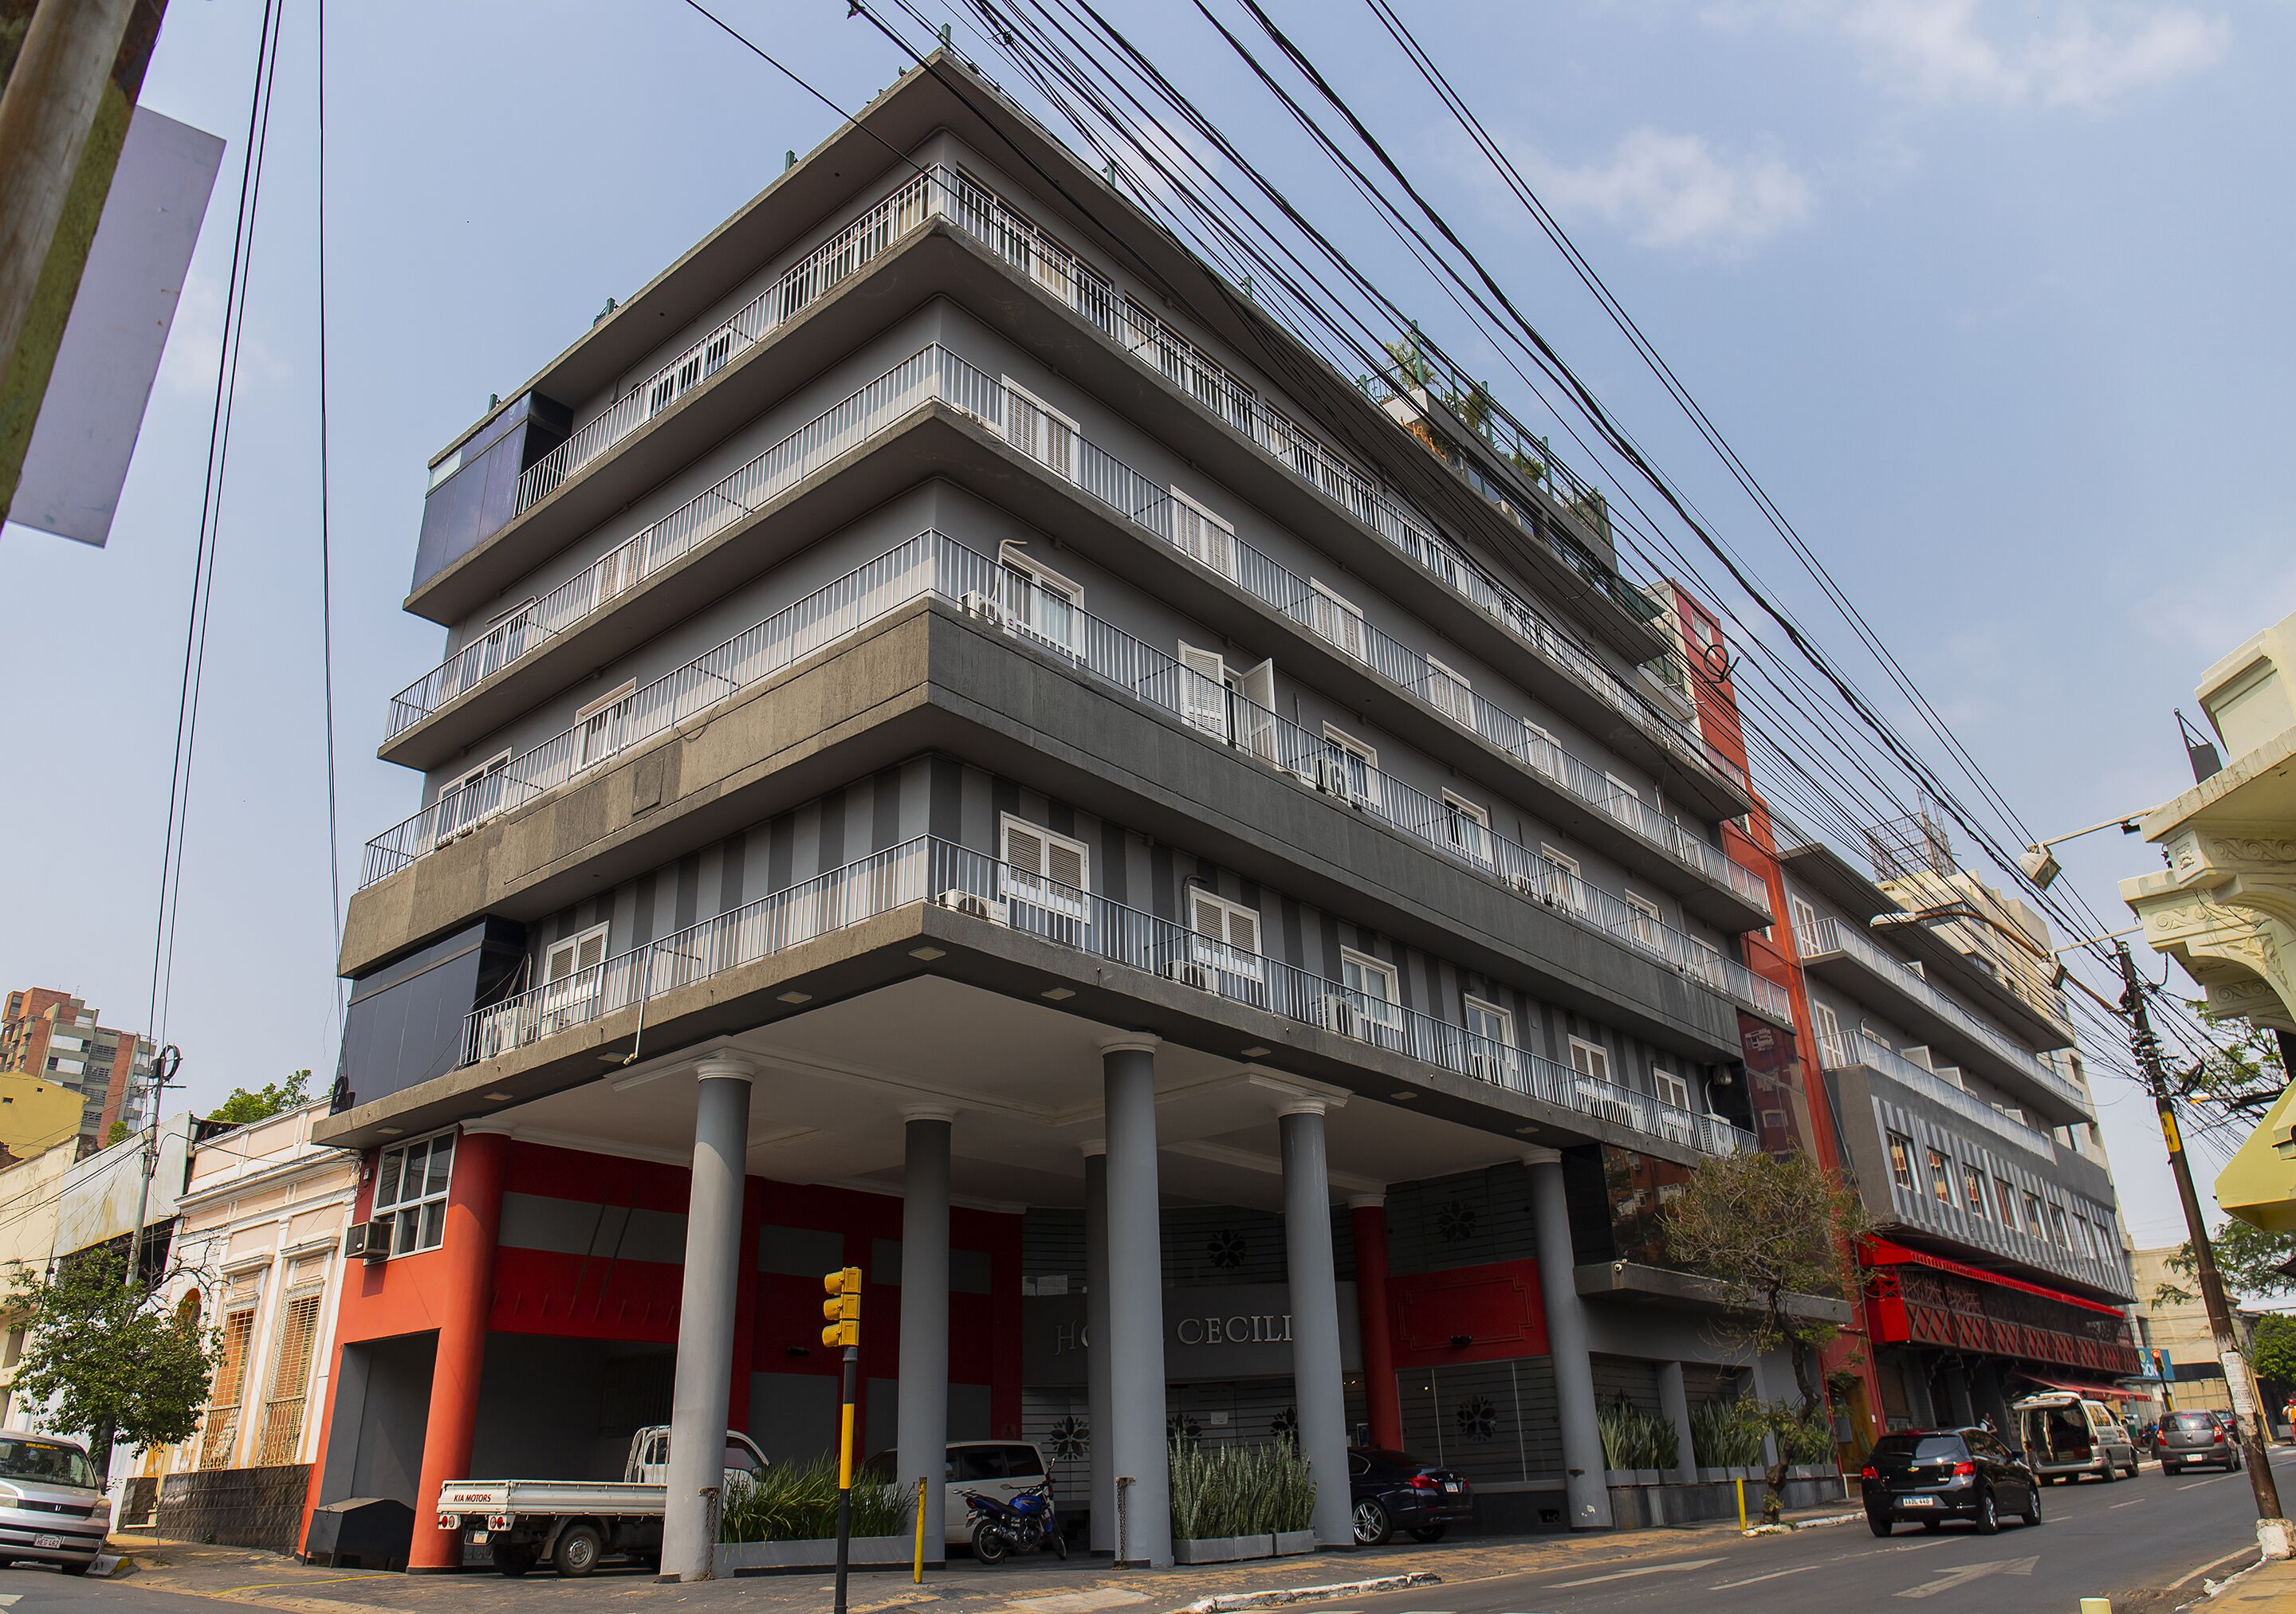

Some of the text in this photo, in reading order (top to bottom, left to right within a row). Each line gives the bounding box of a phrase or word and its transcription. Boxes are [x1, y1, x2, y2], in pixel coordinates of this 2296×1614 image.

[1177, 1314, 1293, 1345] CECILI
[454, 1494, 492, 1502] KIA MOTORS
